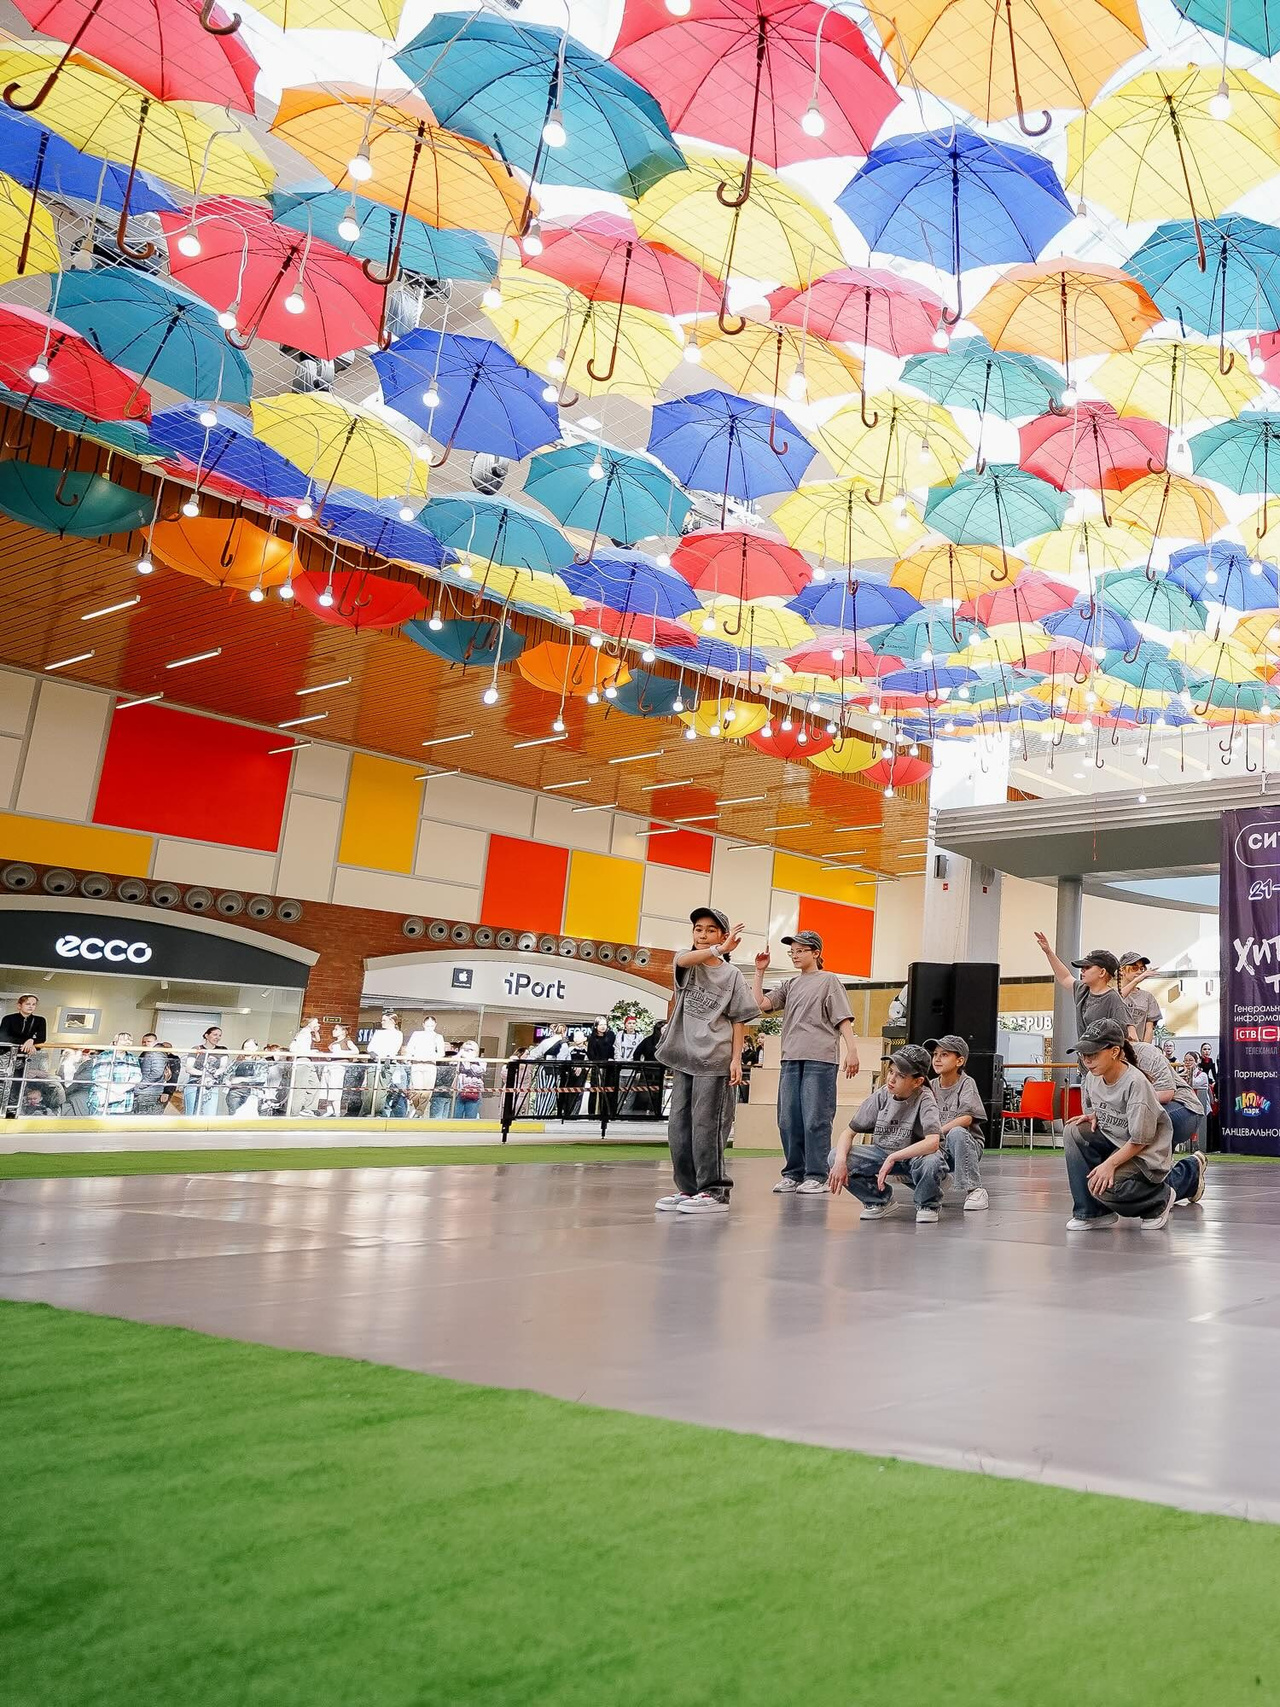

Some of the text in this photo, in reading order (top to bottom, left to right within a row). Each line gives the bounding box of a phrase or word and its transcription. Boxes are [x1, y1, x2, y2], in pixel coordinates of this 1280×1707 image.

[55, 935, 152, 964] ecco
[504, 972, 566, 1000] iPort
[1234, 1070, 1278, 1080] Партнеры:
